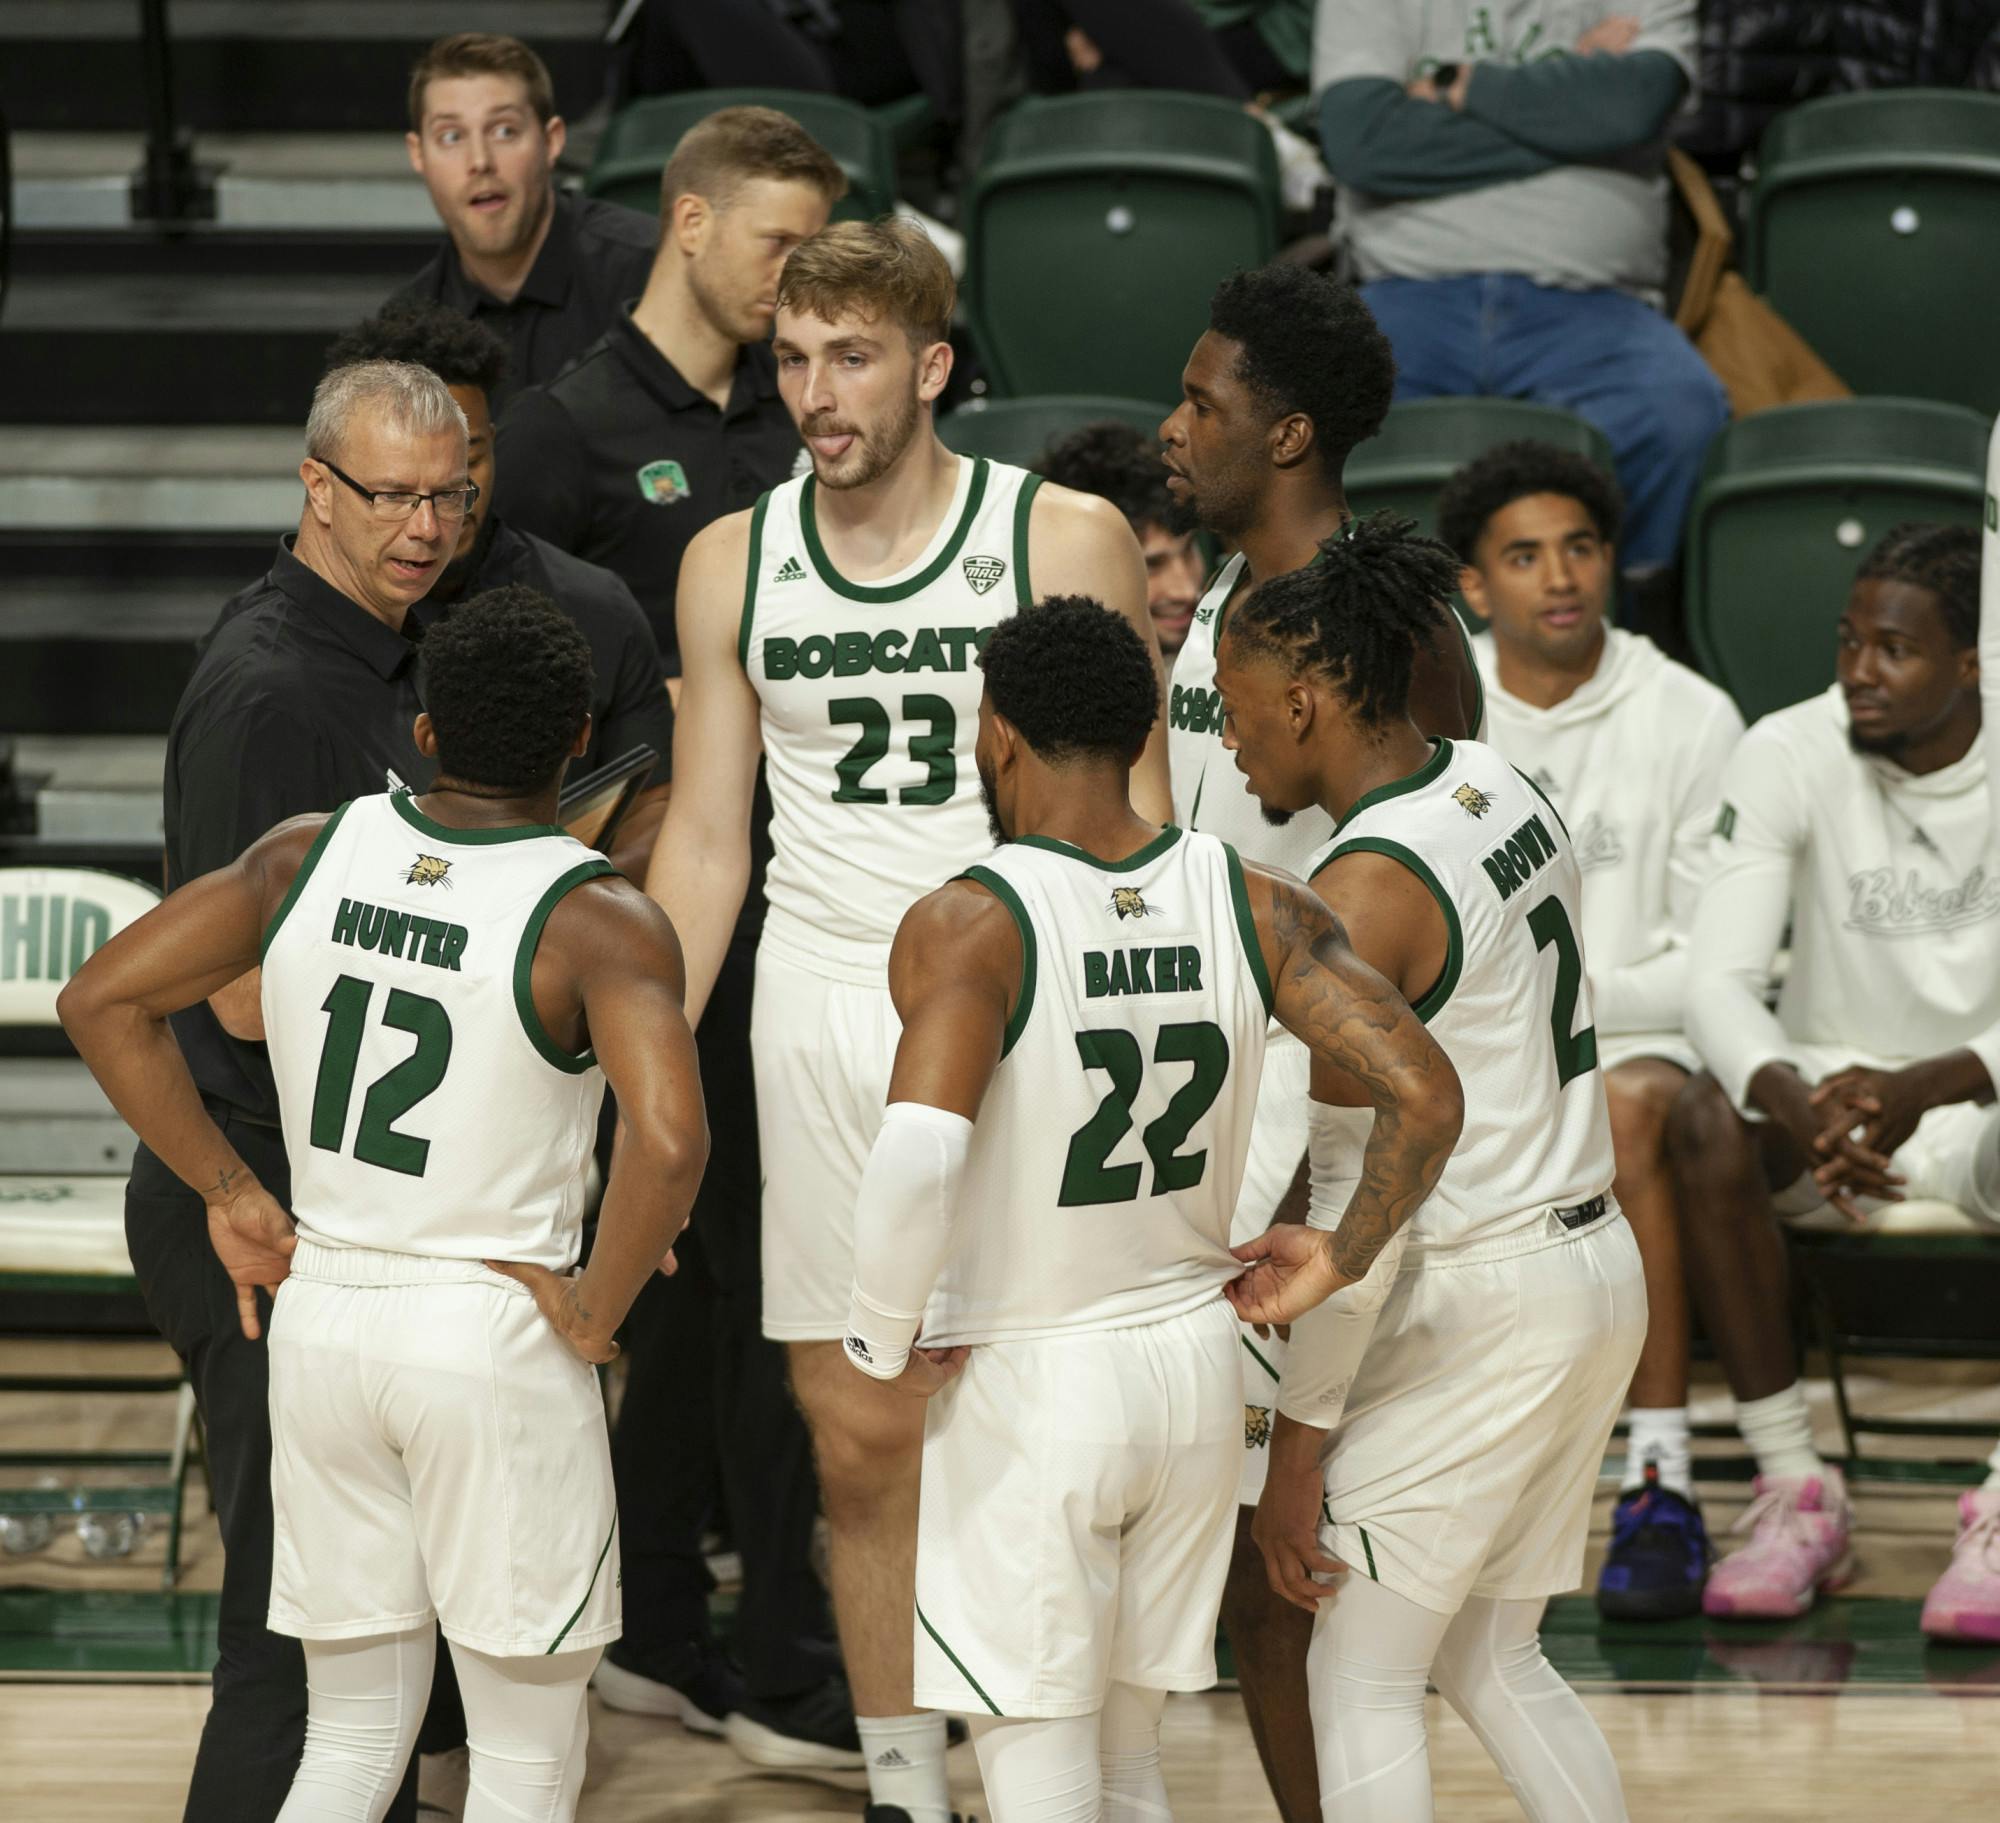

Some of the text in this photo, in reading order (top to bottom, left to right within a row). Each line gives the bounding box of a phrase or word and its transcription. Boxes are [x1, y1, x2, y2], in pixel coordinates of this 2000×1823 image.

[773, 571, 808, 583] adidas
[828, 693, 957, 805] 23
[1481, 813, 1558, 902] BROWN
[331, 897, 469, 972] HUNTER
[1083, 945, 1204, 998] BAKER
[1526, 894, 1598, 1092] 2
[310, 973, 453, 1178] 12
[1057, 1020, 1230, 1207] 22
